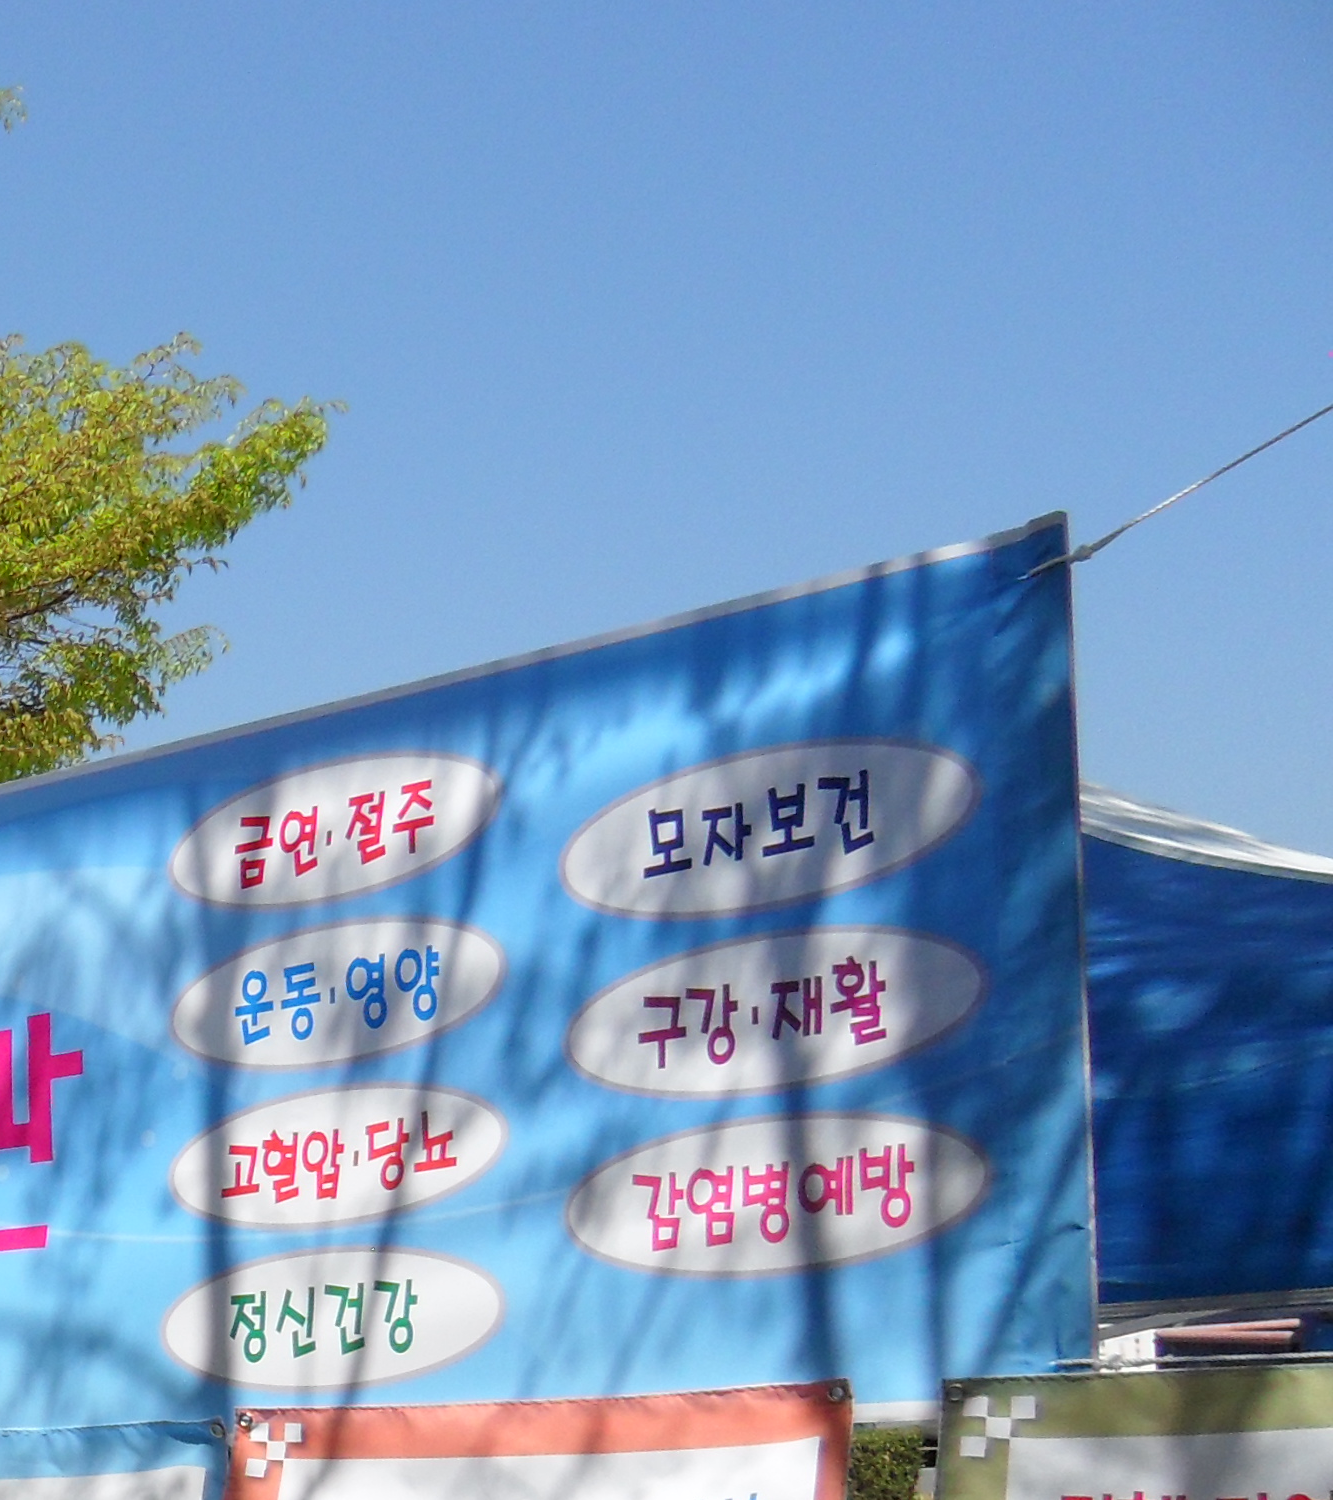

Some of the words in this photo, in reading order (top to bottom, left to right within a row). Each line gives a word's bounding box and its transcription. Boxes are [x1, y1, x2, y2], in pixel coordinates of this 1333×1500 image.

[642, 770, 874, 879] 모자보건
[631, 1143, 915, 1253] 감염병예방
[229, 1279, 418, 1364] 정신건강
